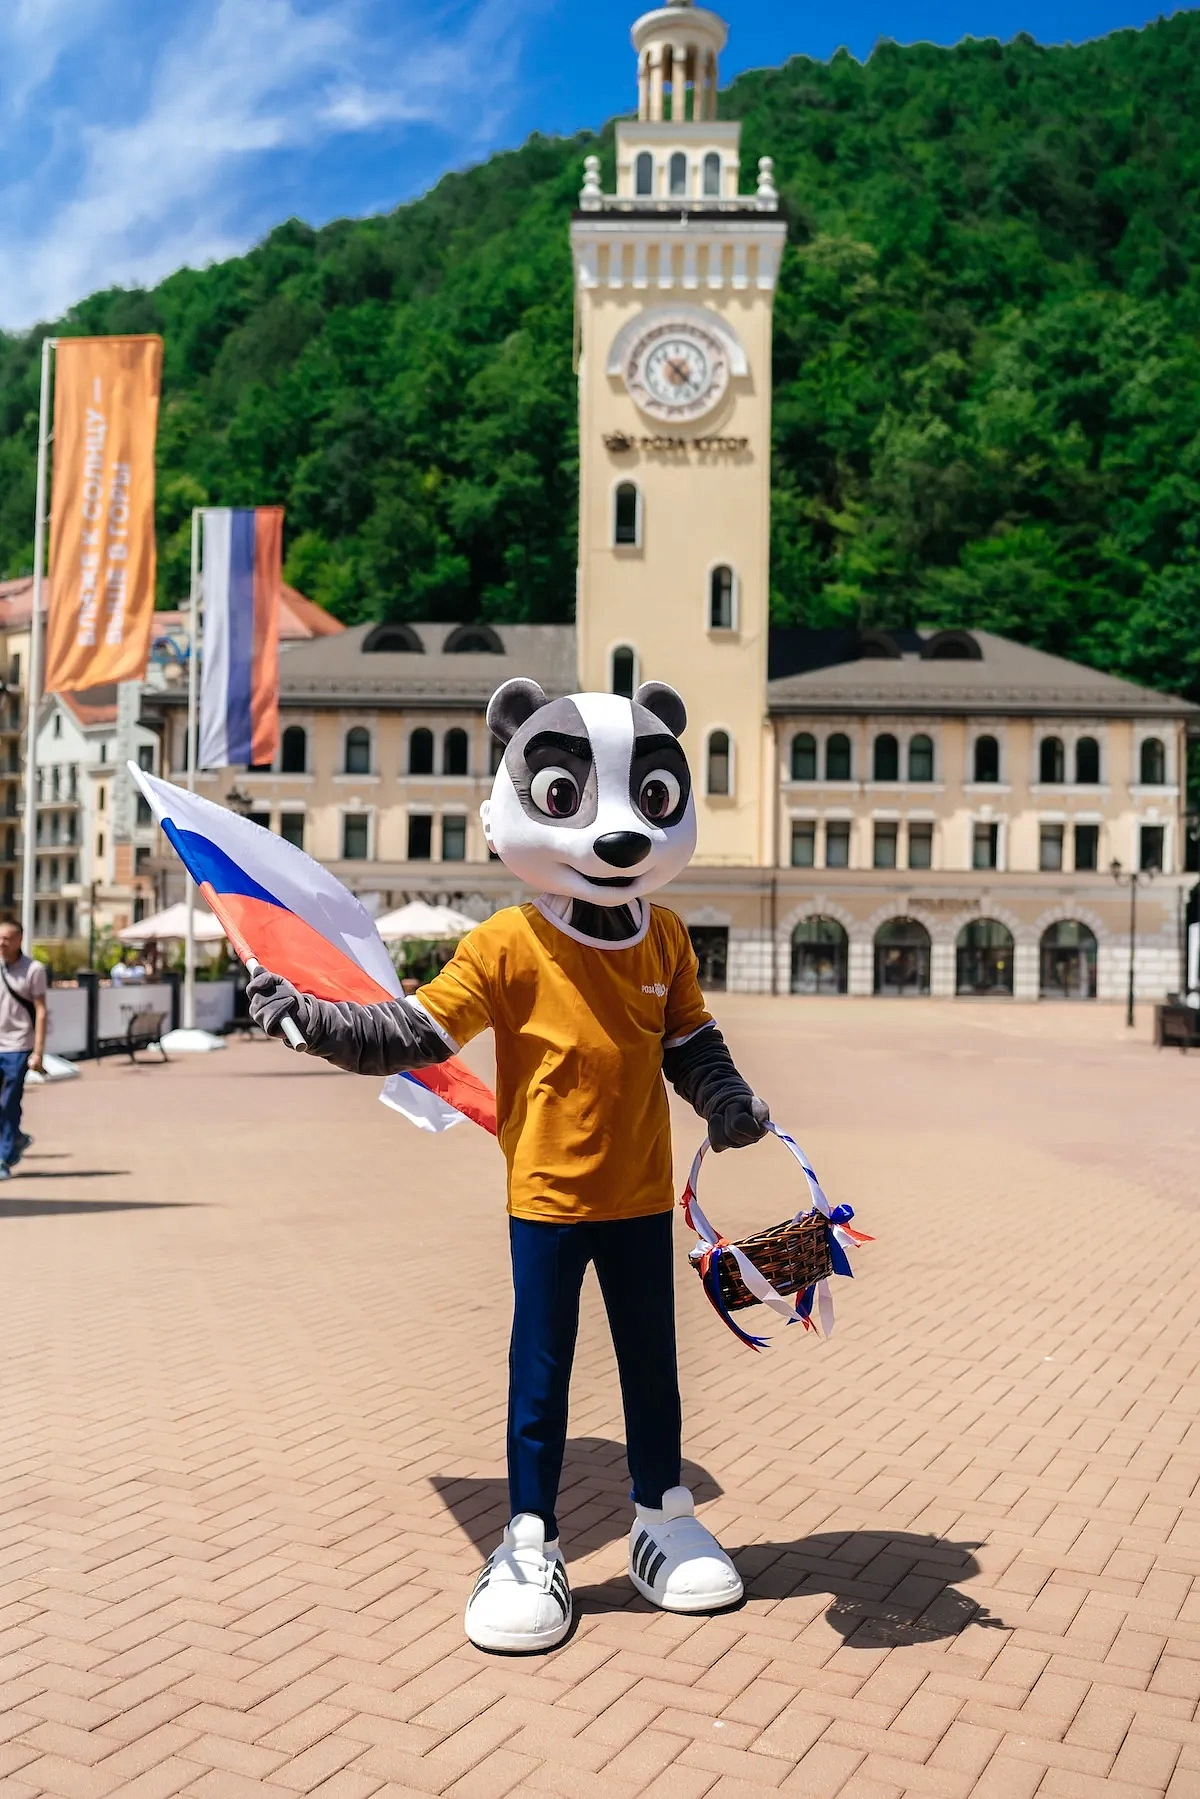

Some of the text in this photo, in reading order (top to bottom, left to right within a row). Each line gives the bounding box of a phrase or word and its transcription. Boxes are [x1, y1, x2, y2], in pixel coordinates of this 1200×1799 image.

[83, 407, 106, 520] СОЛНЦУ
[641, 436, 685, 451] РОЗА
[82, 527, 100, 545] К
[106, 463, 130, 644] ВЫШЕ В ГОРЫ
[78, 553, 99, 645] БЛИЖЕ
